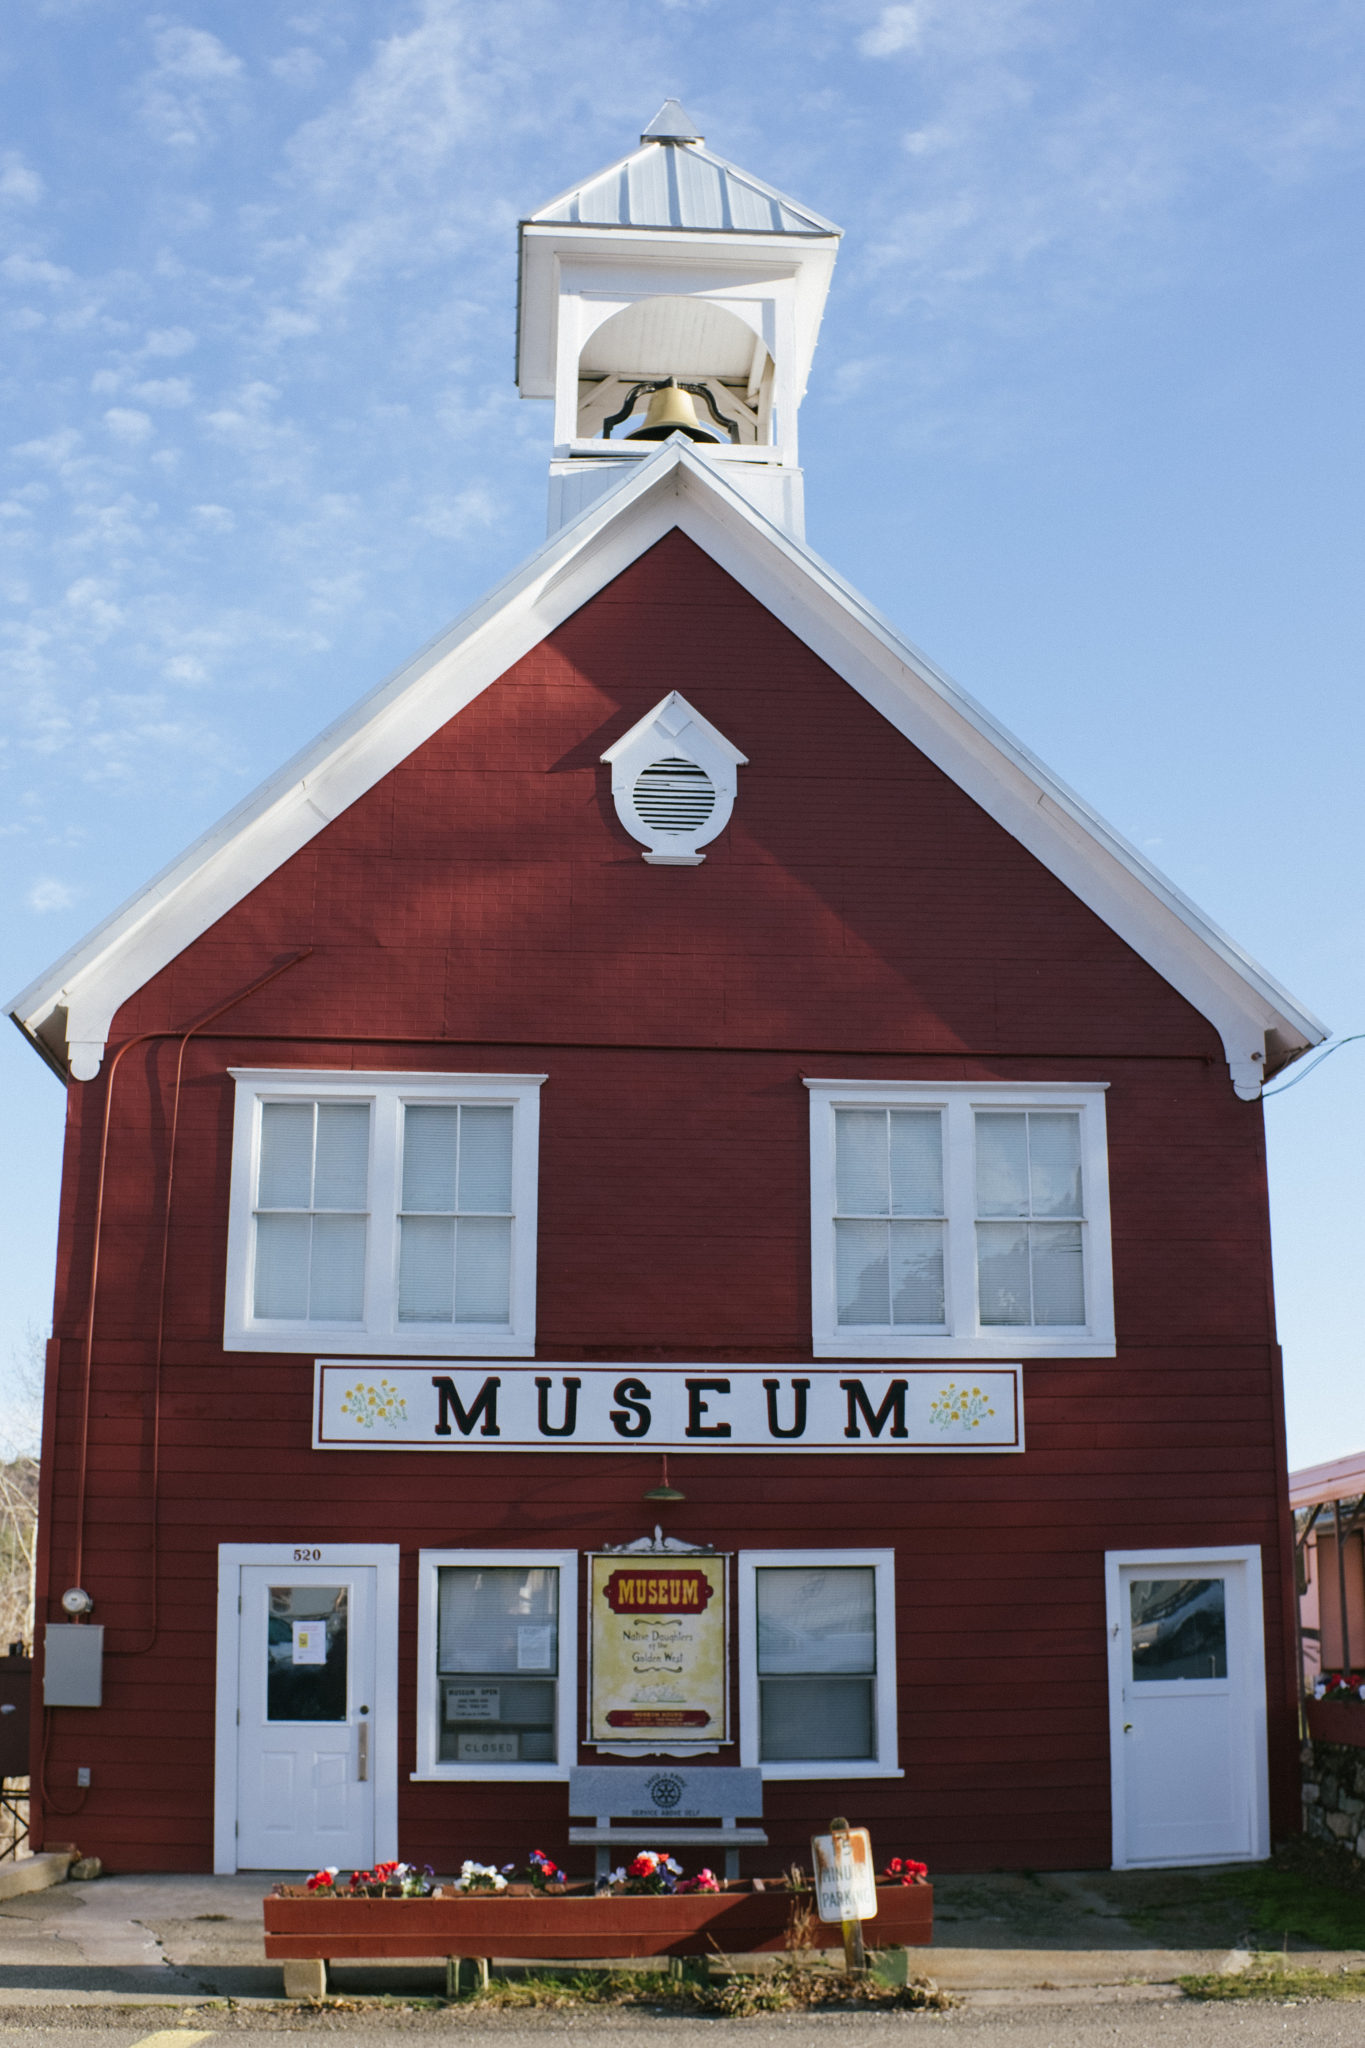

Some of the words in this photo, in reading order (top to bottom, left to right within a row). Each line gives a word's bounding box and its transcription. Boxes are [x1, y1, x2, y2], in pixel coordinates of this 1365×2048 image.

[432, 1376, 909, 1438] MUSEUM
[293, 1549, 321, 1561] 520
[618, 1579, 699, 1605] MUSEUM
[622, 1630, 648, 1641] Native
[652, 1630, 693, 1643] Daughters
[632, 1651, 661, 1662] Golden
[664, 1652, 683, 1662] West
[464, 1743, 513, 1753] CLOSED
[631, 1809, 657, 1817] SERVICE
[661, 1809, 682, 1817] ABOVE
[684, 1809, 700, 1817] SELF
